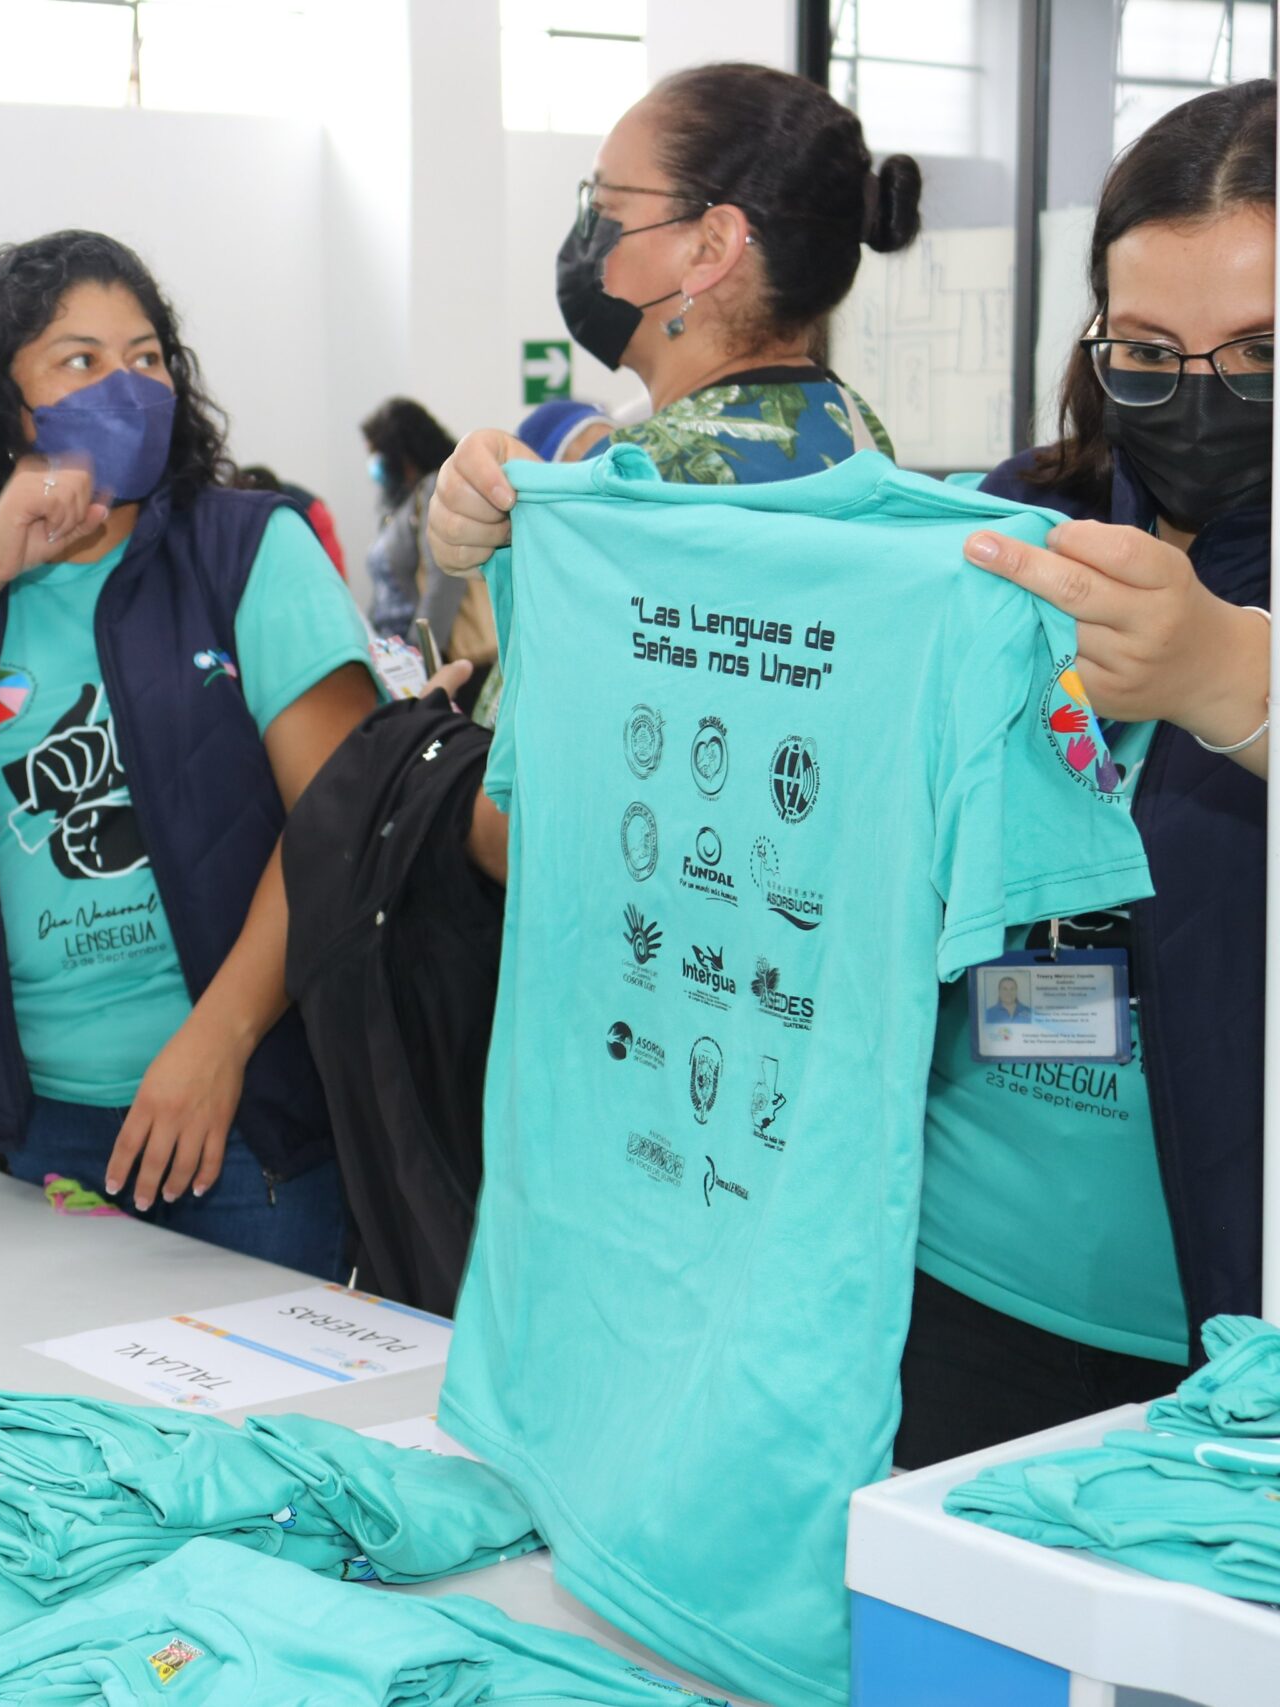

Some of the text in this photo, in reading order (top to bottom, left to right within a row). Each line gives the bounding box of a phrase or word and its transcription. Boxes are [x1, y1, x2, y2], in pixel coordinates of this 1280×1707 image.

[630, 596, 836, 652] "Las Lenguas de
[632, 632, 833, 690] Señas nos Unen"
[683, 855, 735, 888] FUNDAL
[75, 892, 158, 928] Nacional
[64, 920, 158, 958] LENSEGUA
[80, 956, 95, 967] de
[682, 957, 737, 995] Intergua
[985, 1071, 1130, 1121] 23 de Septiembre
[278, 1306, 419, 1353] PLAYERAS
[114, 1342, 158, 1359] XL
[146, 1354, 233, 1391] TALLA
